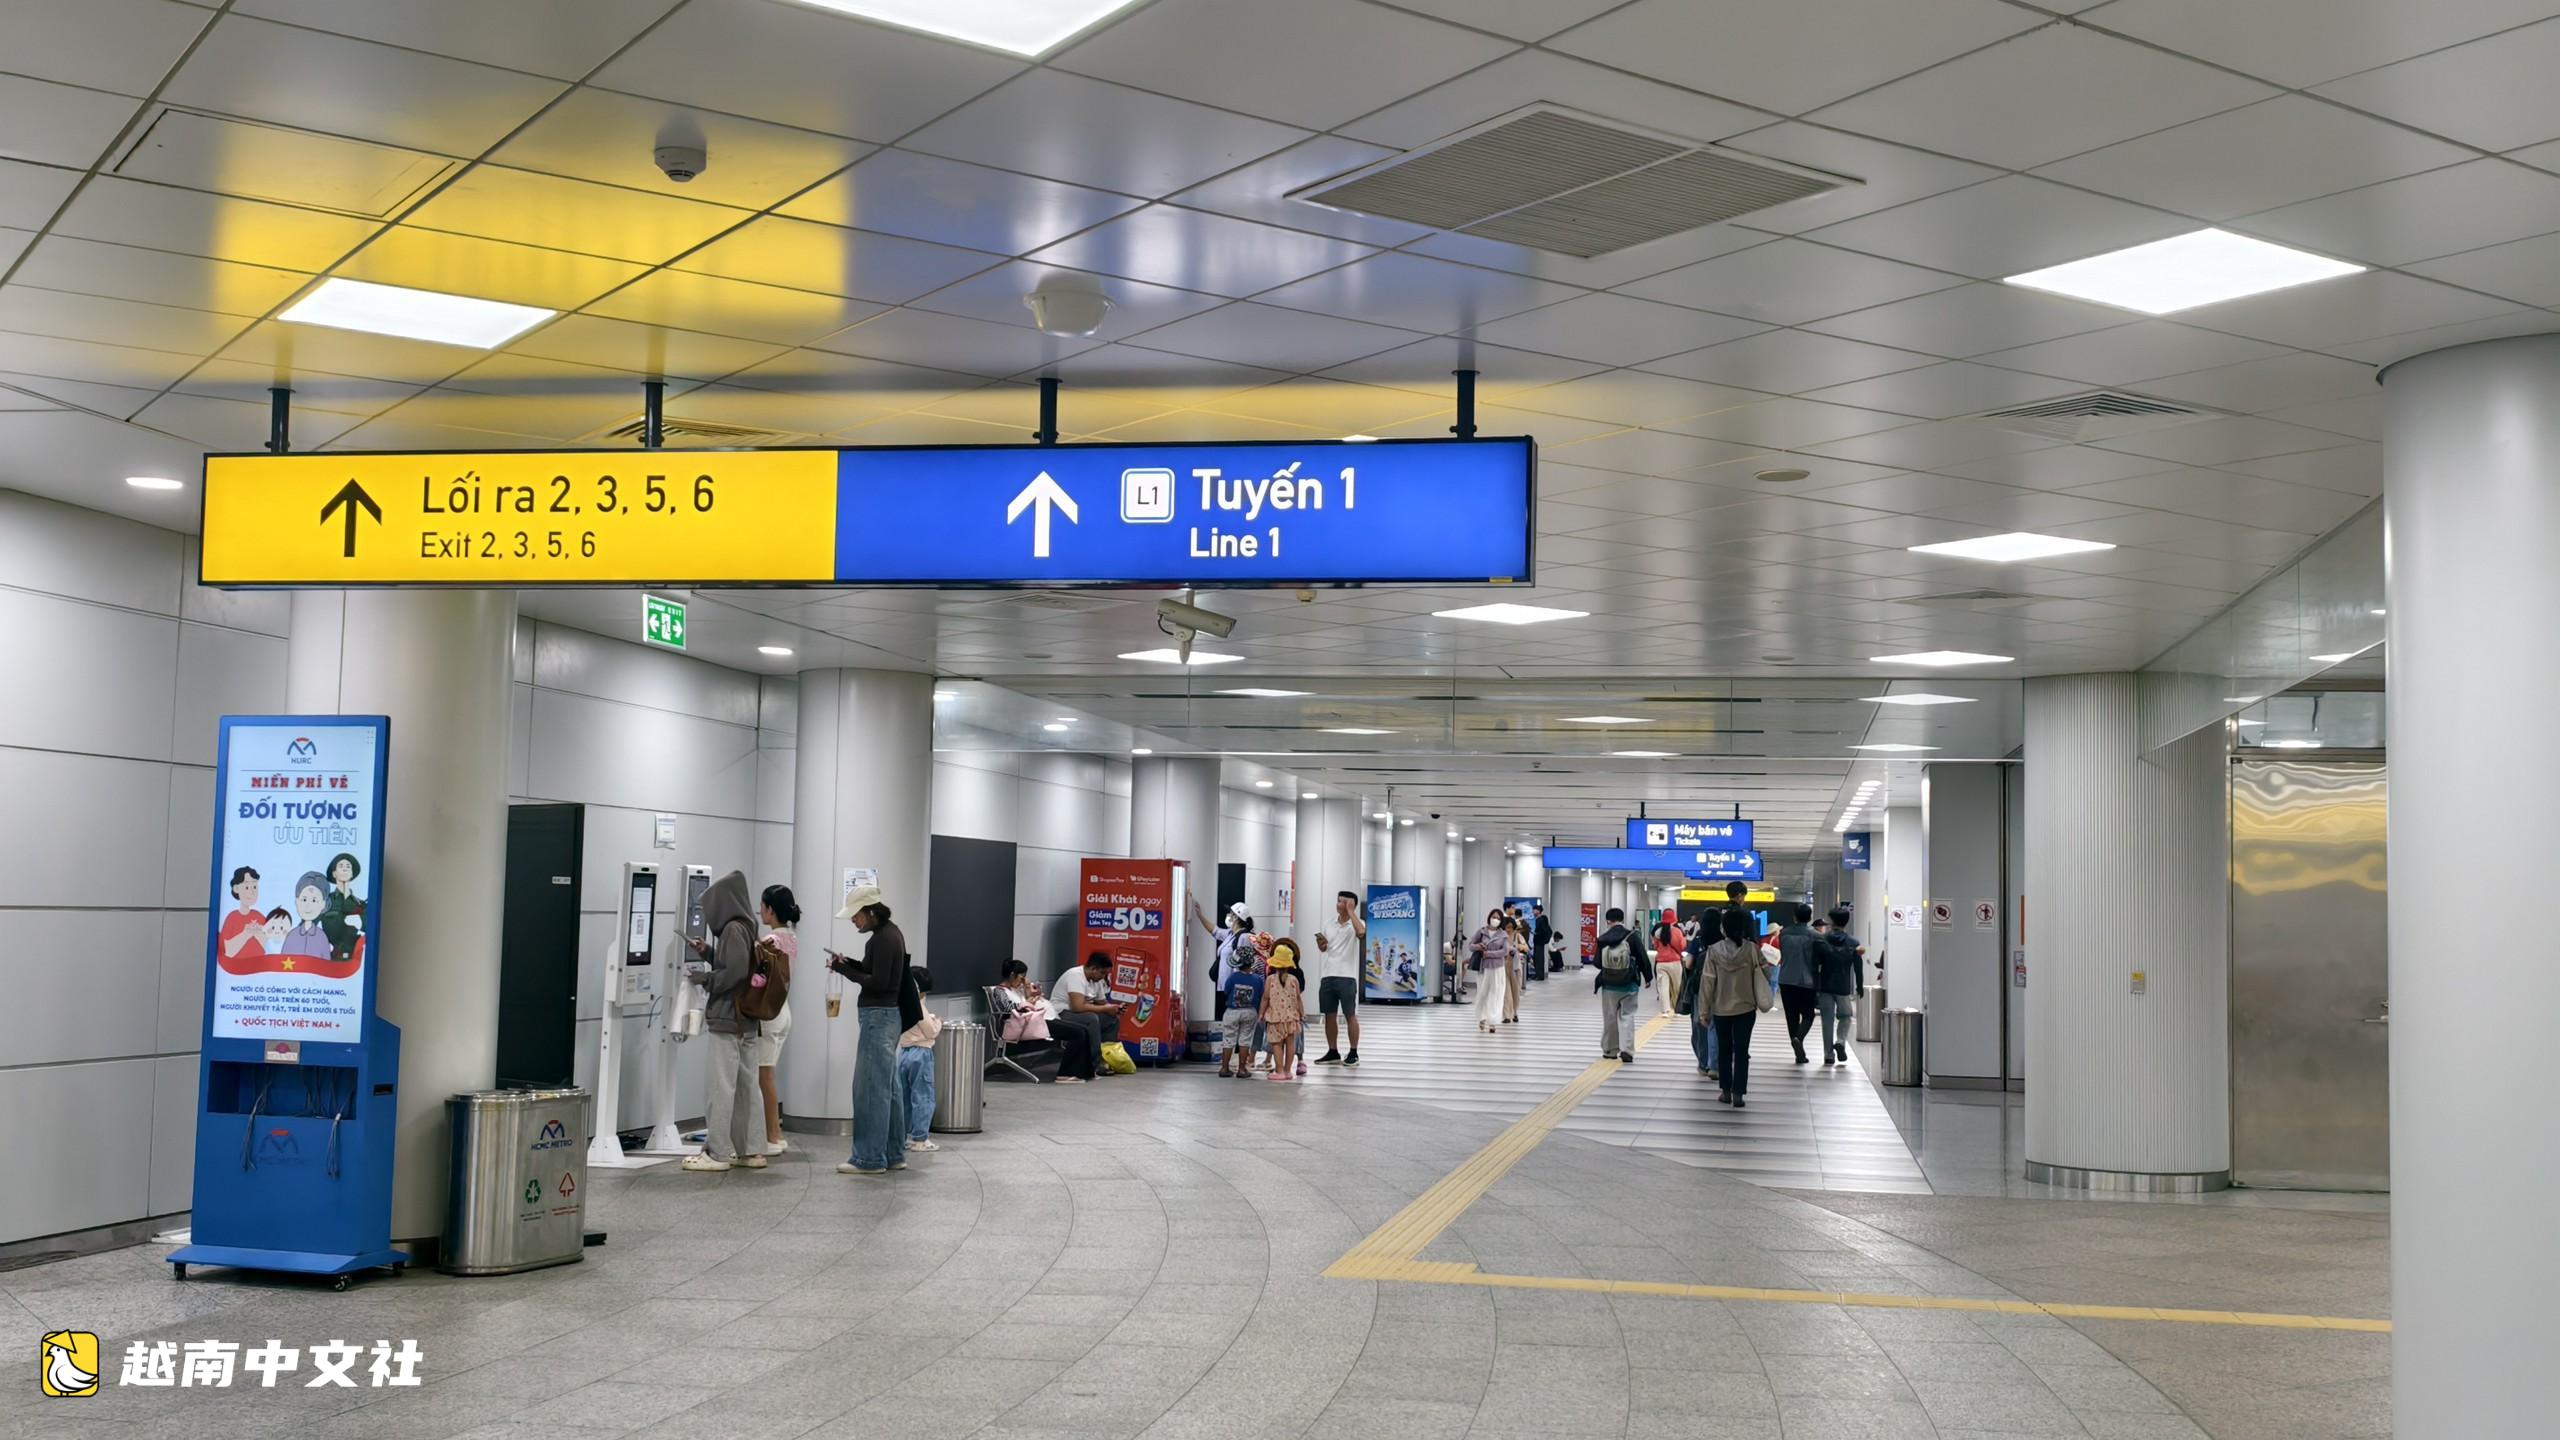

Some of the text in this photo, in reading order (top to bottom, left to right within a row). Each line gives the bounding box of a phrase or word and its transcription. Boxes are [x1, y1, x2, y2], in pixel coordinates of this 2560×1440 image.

[423, 471, 714, 516] Lối ra 2, 3, 5, 6
[1137, 485, 1159, 506] L1
[1192, 461, 1356, 521] Tuyến 1
[421, 531, 596, 560] Exit 2, 3, 5, 6
[1190, 527, 1280, 558] Line 1
[291, 757, 312, 765] HURC
[296, 774, 322, 788] PHÍ
[329, 774, 349, 789] VÉ
[238, 796, 357, 824] ĐỐI TƯỢNG
[273, 821, 358, 845] ƯU TIÊN
[1674, 824, 1696, 837] Máy
[1698, 824, 1718, 836] bán
[1087, 893, 1108, 903] Giải
[1111, 893, 1137, 904] Khát
[242, 1016, 266, 1026] QUỐC
[312, 1020, 332, 1028] NAM
